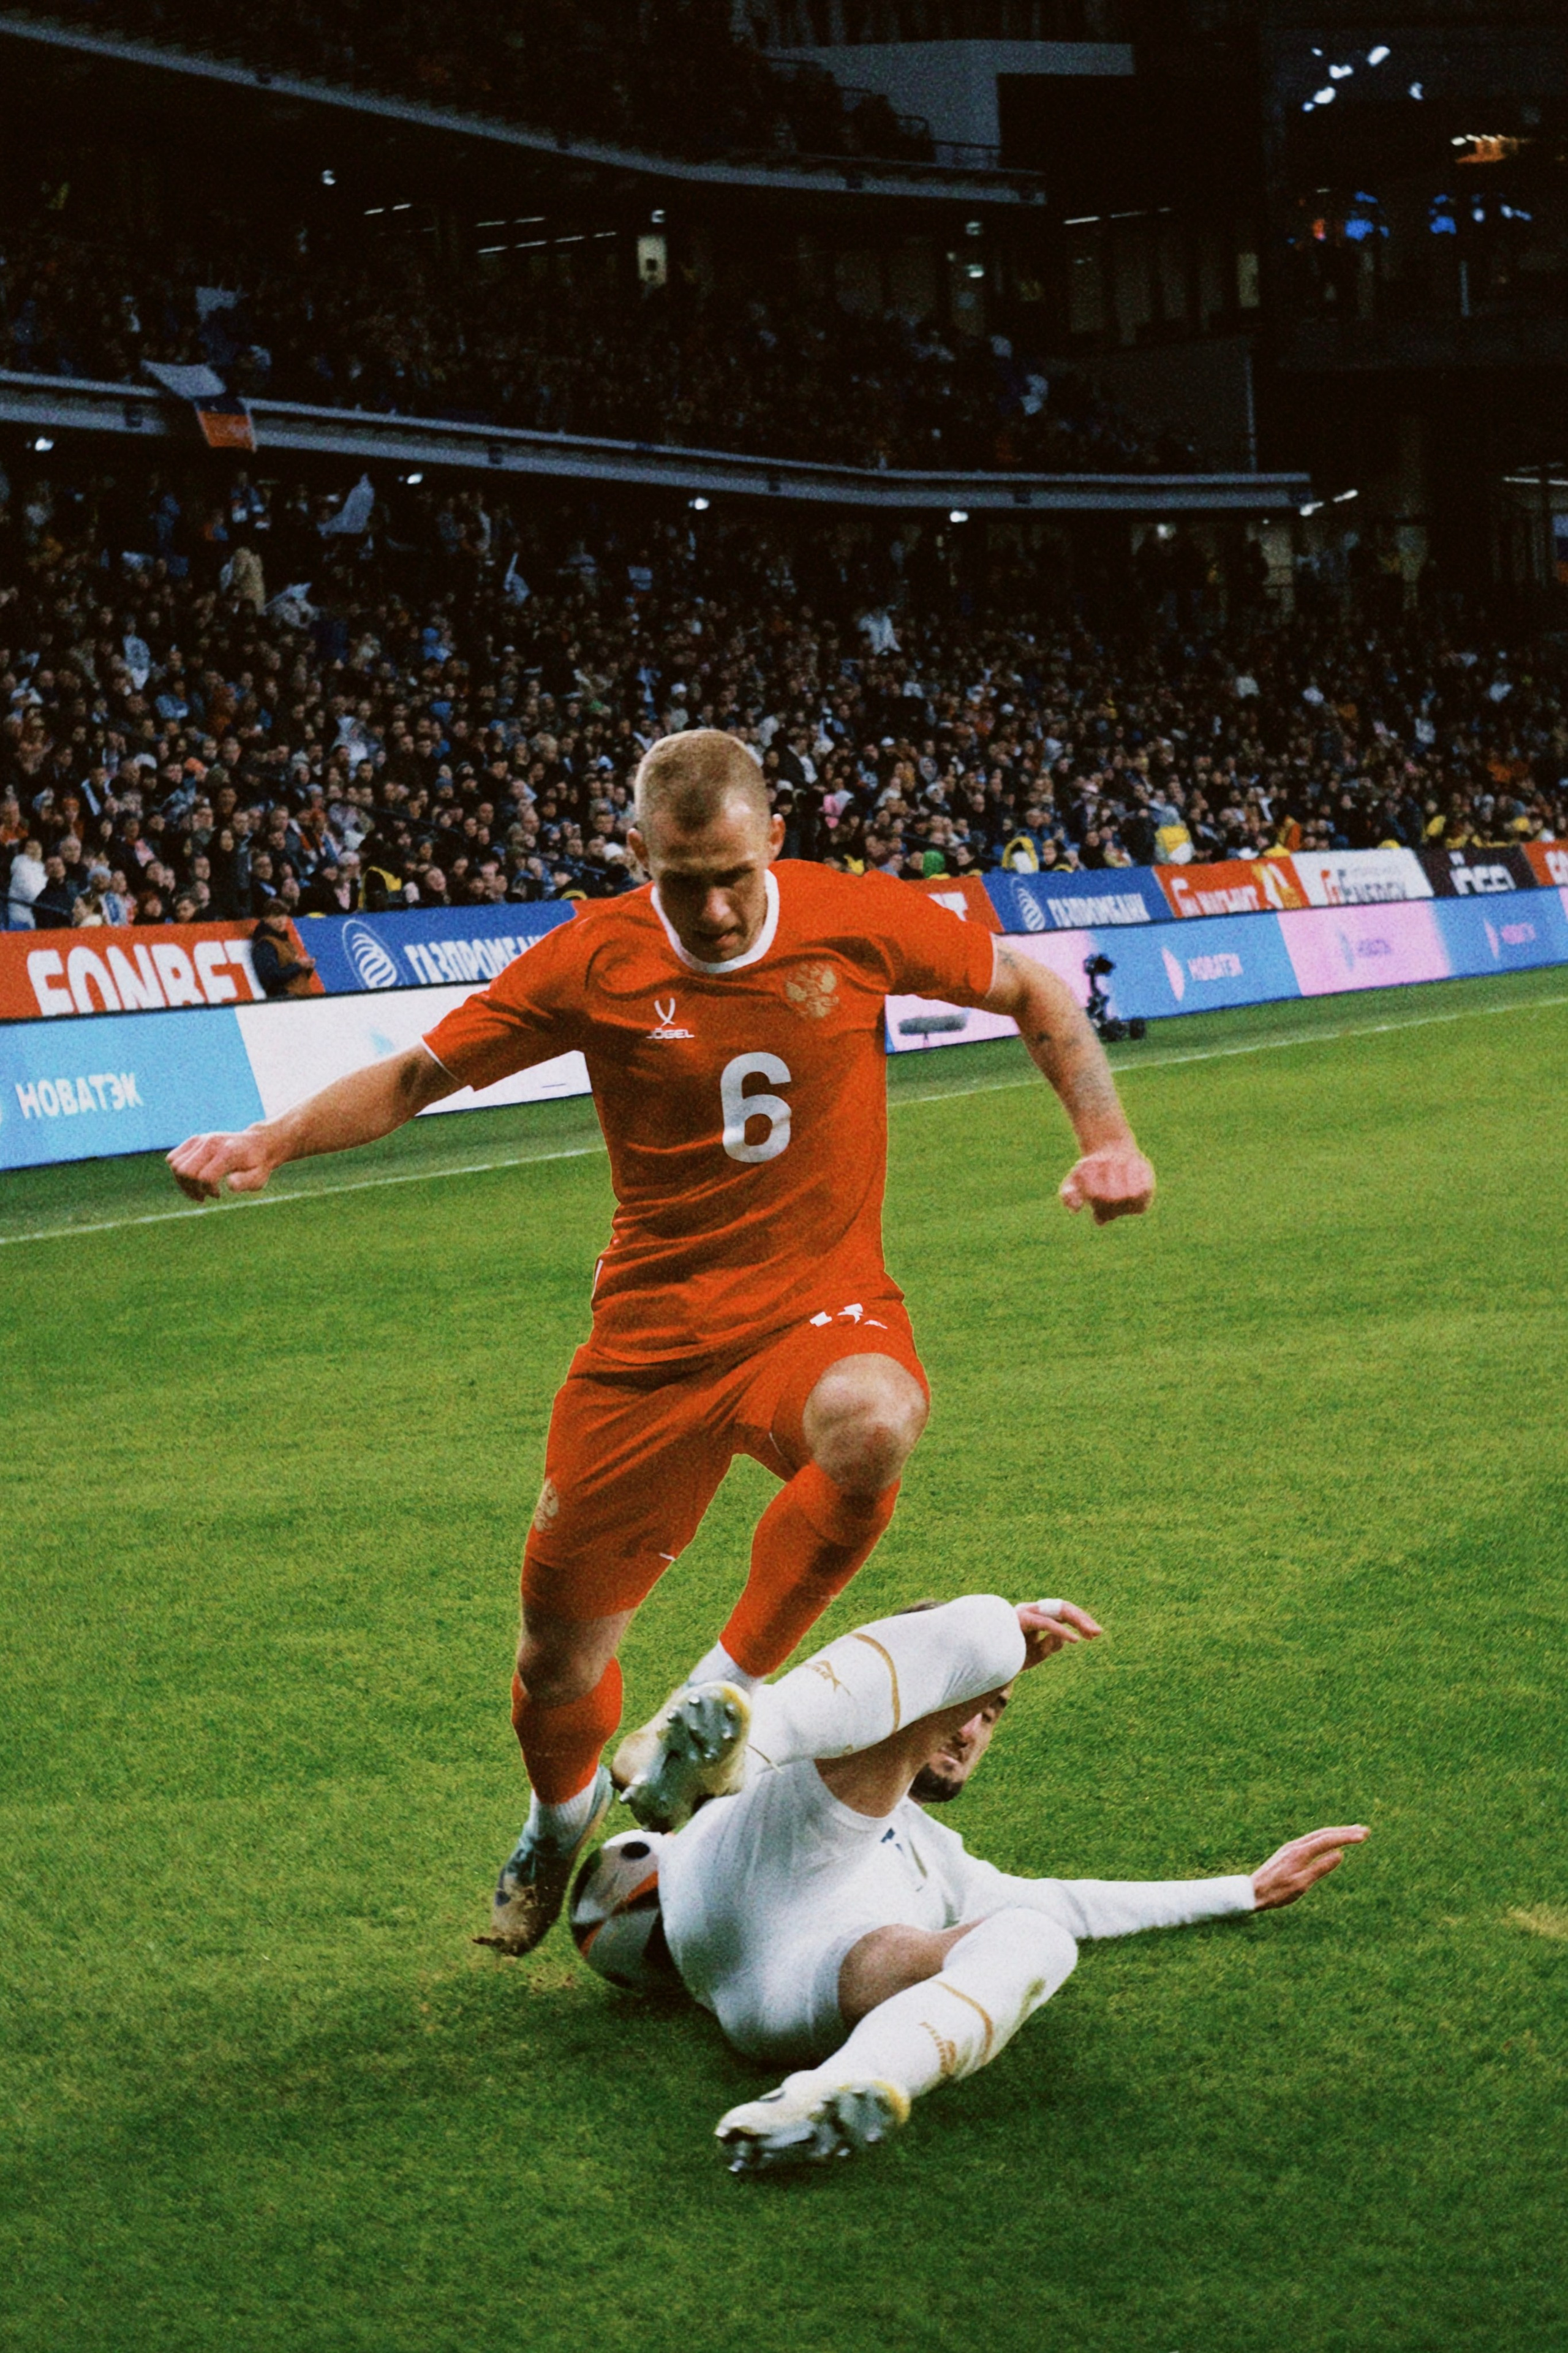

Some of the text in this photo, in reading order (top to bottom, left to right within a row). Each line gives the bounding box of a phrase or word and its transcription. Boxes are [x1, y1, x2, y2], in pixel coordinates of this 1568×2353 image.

[26, 939, 267, 1017] FONBET
[15, 1072, 144, 1120] НОВАТЭК
[720, 1051, 792, 1163] 6
